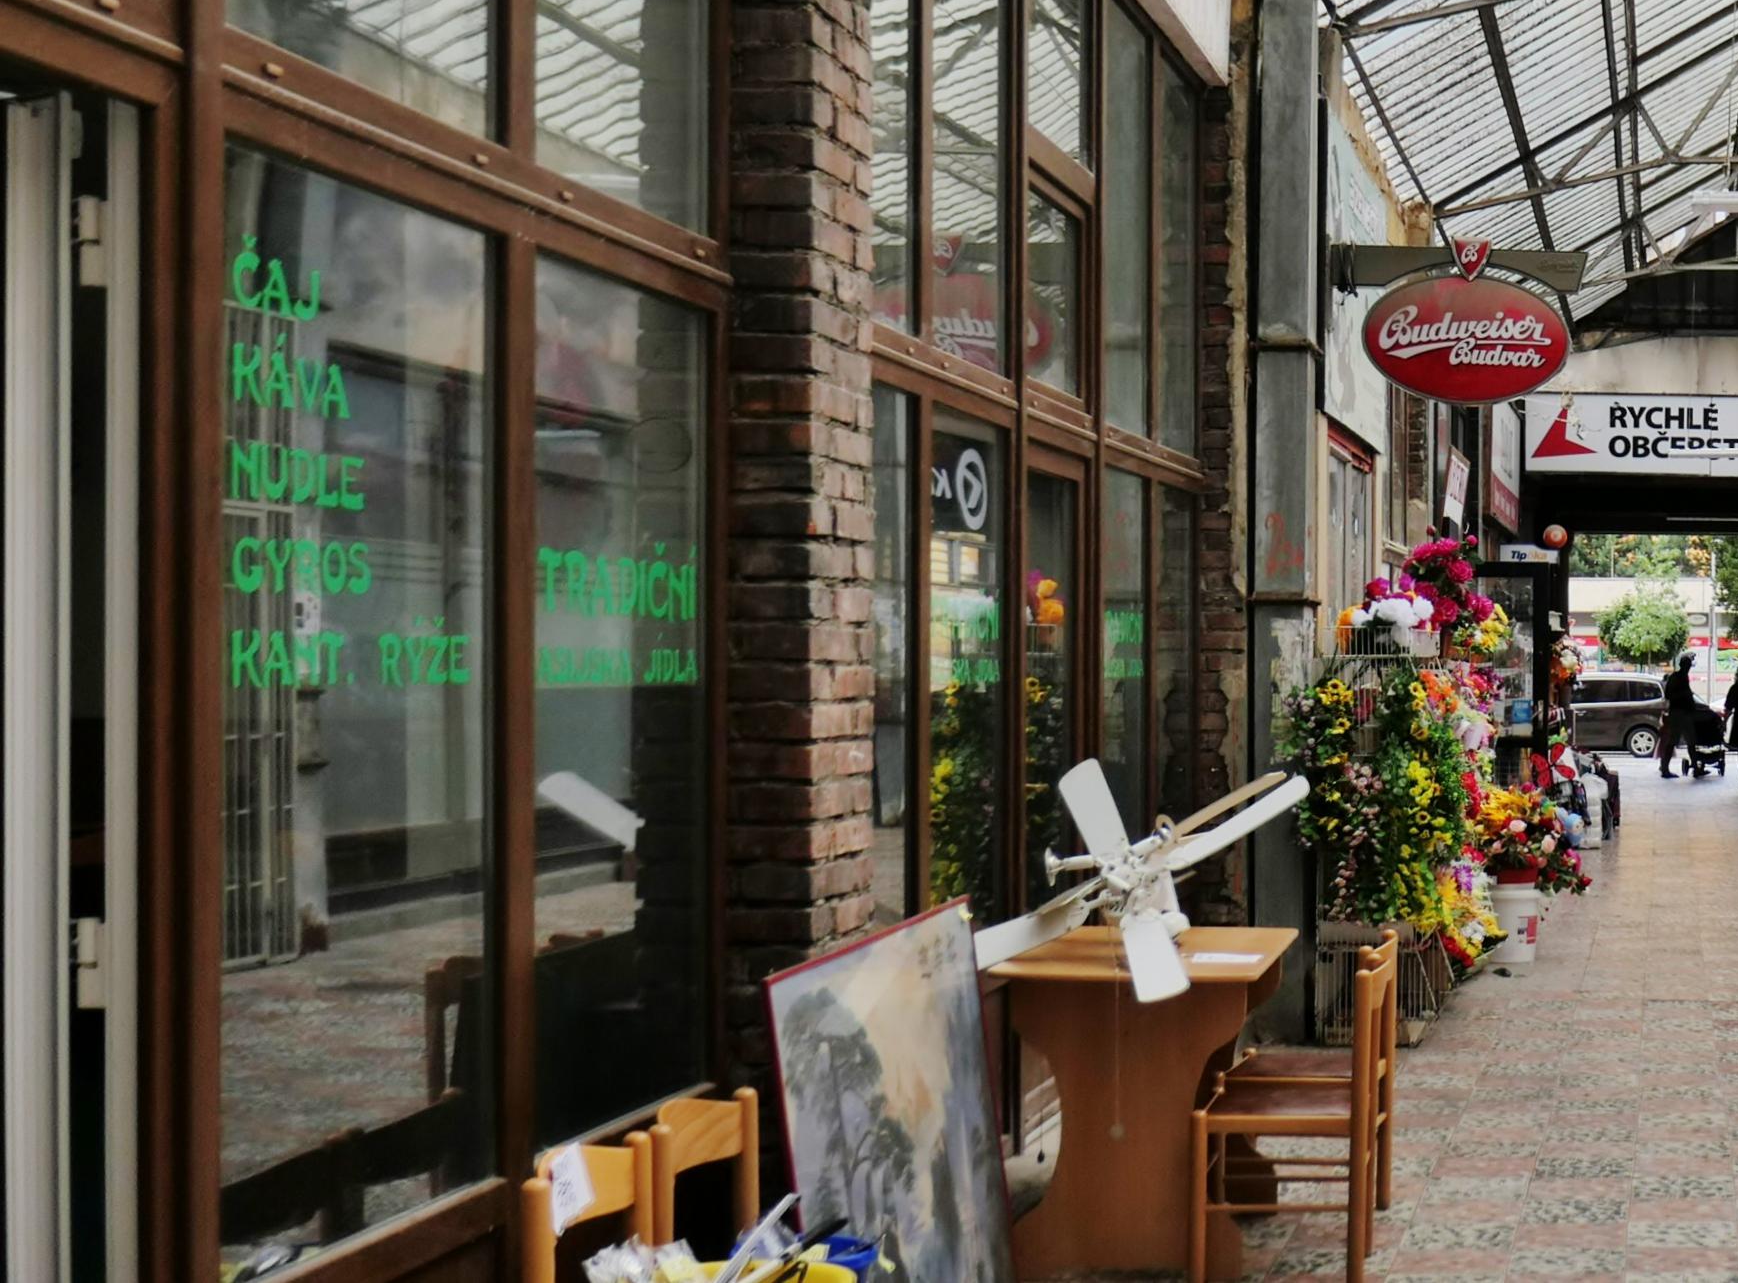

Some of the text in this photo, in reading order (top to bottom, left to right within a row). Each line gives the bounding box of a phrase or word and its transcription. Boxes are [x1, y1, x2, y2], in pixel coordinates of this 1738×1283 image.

[232, 234, 321, 321] ČAJ
[1378, 304, 1552, 351] Budweiser
[1449, 337, 1545, 367] Budvar
[232, 332, 350, 419] KÁVA
[1609, 402, 1719, 430] RYCHLÉ
[230, 440, 366, 511] NUDLE
[231, 535, 373, 595] GYROS
[537, 541, 697, 623] TRADIČNÍ
[230, 615, 471, 690] KANT. RÝŽE
[643, 632, 698, 685] JÍDLA
